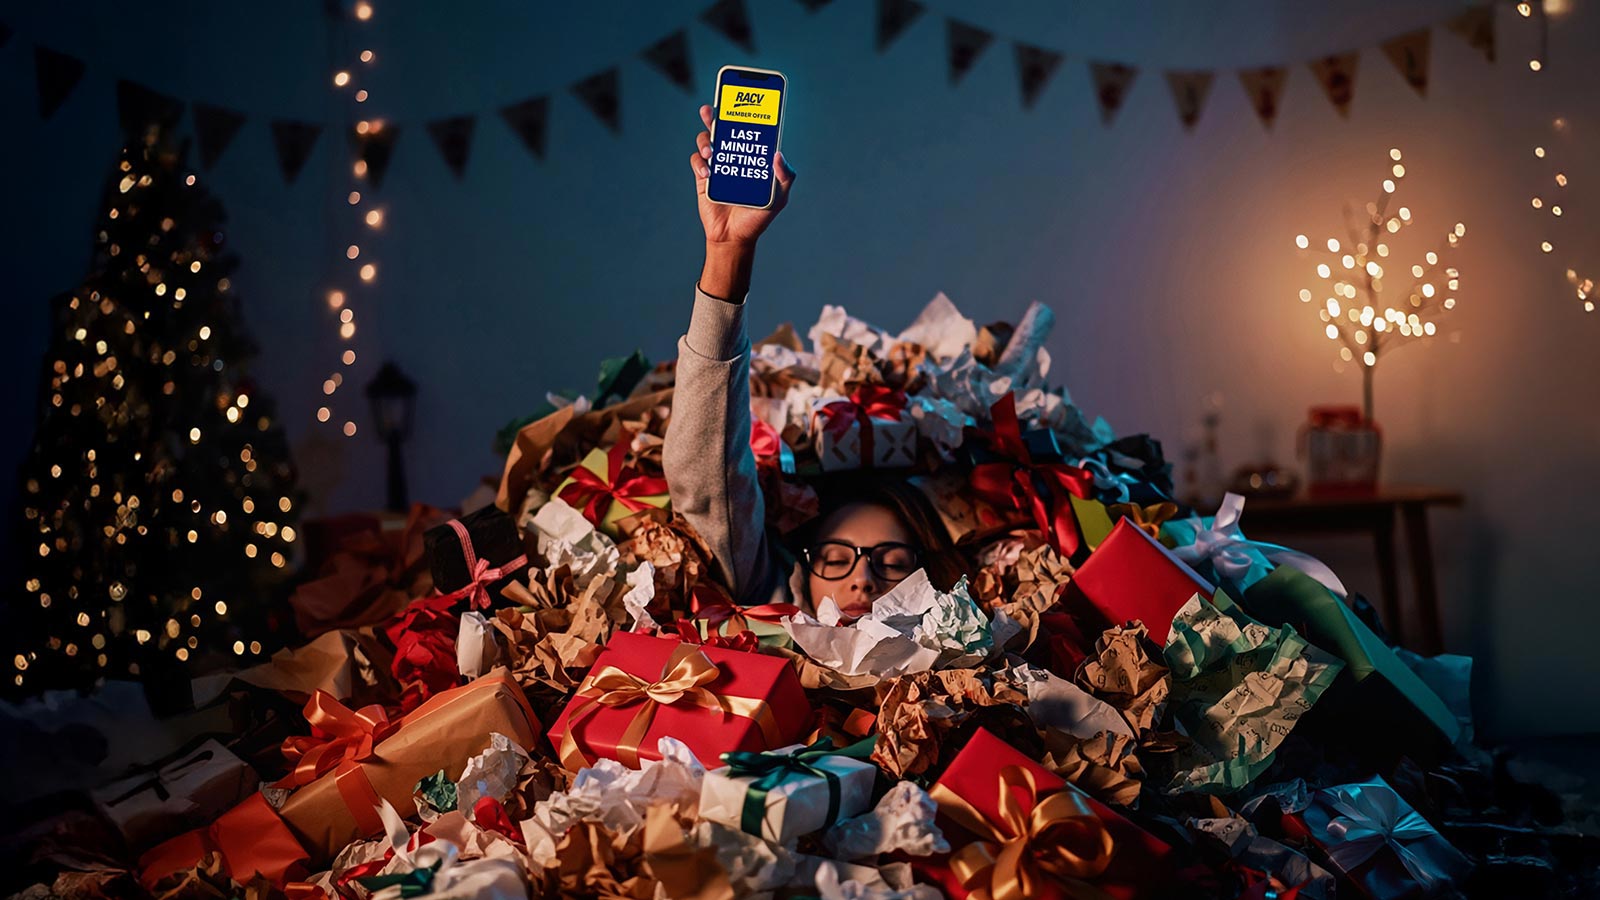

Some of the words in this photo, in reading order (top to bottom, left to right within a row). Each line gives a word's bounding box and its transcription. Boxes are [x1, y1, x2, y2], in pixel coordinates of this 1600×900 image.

[735, 92, 764, 103] RACV
[731, 129, 761, 141] LAST
[721, 141, 768, 155] MINUTE
[716, 153, 769, 168] GIFTING,
[714, 164, 738, 176] FOR
[741, 168, 769, 180] LESS
